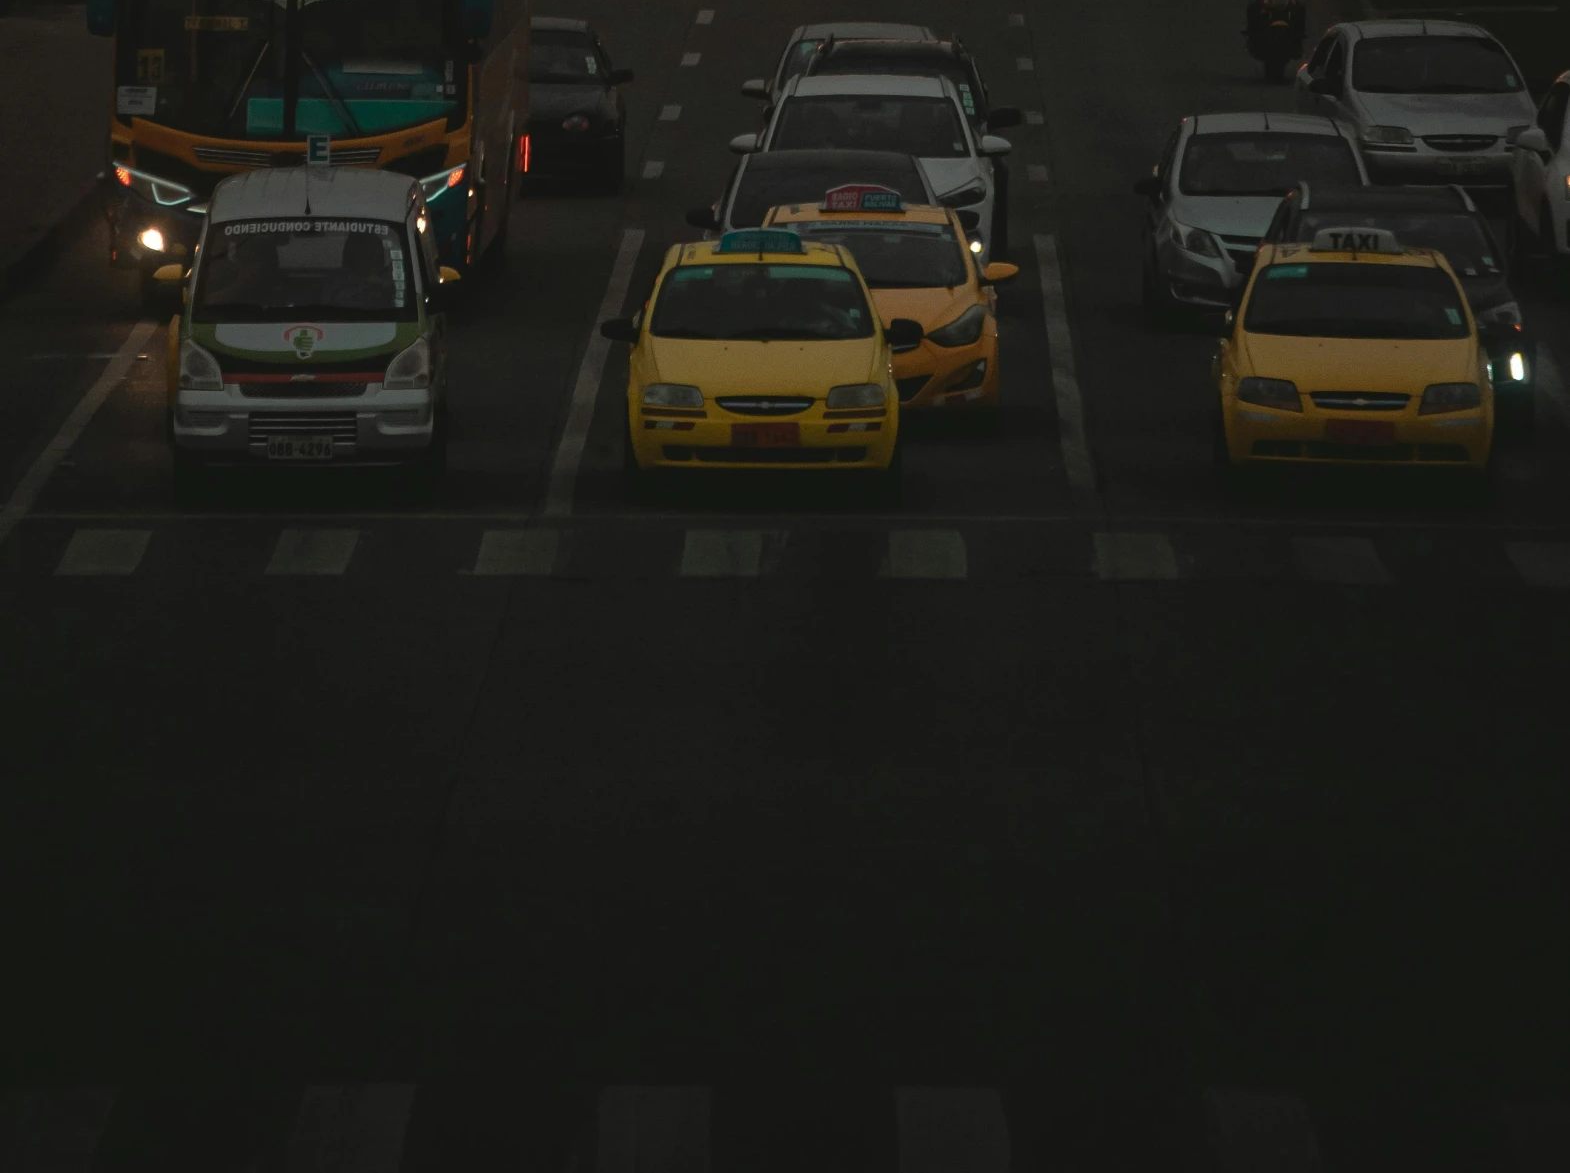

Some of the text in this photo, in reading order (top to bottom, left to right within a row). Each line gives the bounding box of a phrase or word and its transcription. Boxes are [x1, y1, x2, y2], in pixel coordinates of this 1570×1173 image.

[310, 139, 328, 161] E
[831, 192, 858, 201] RADIO
[864, 194, 897, 202] PUERTO
[831, 201, 856, 209] TAXI
[1328, 232, 1379, 251] TAXI
